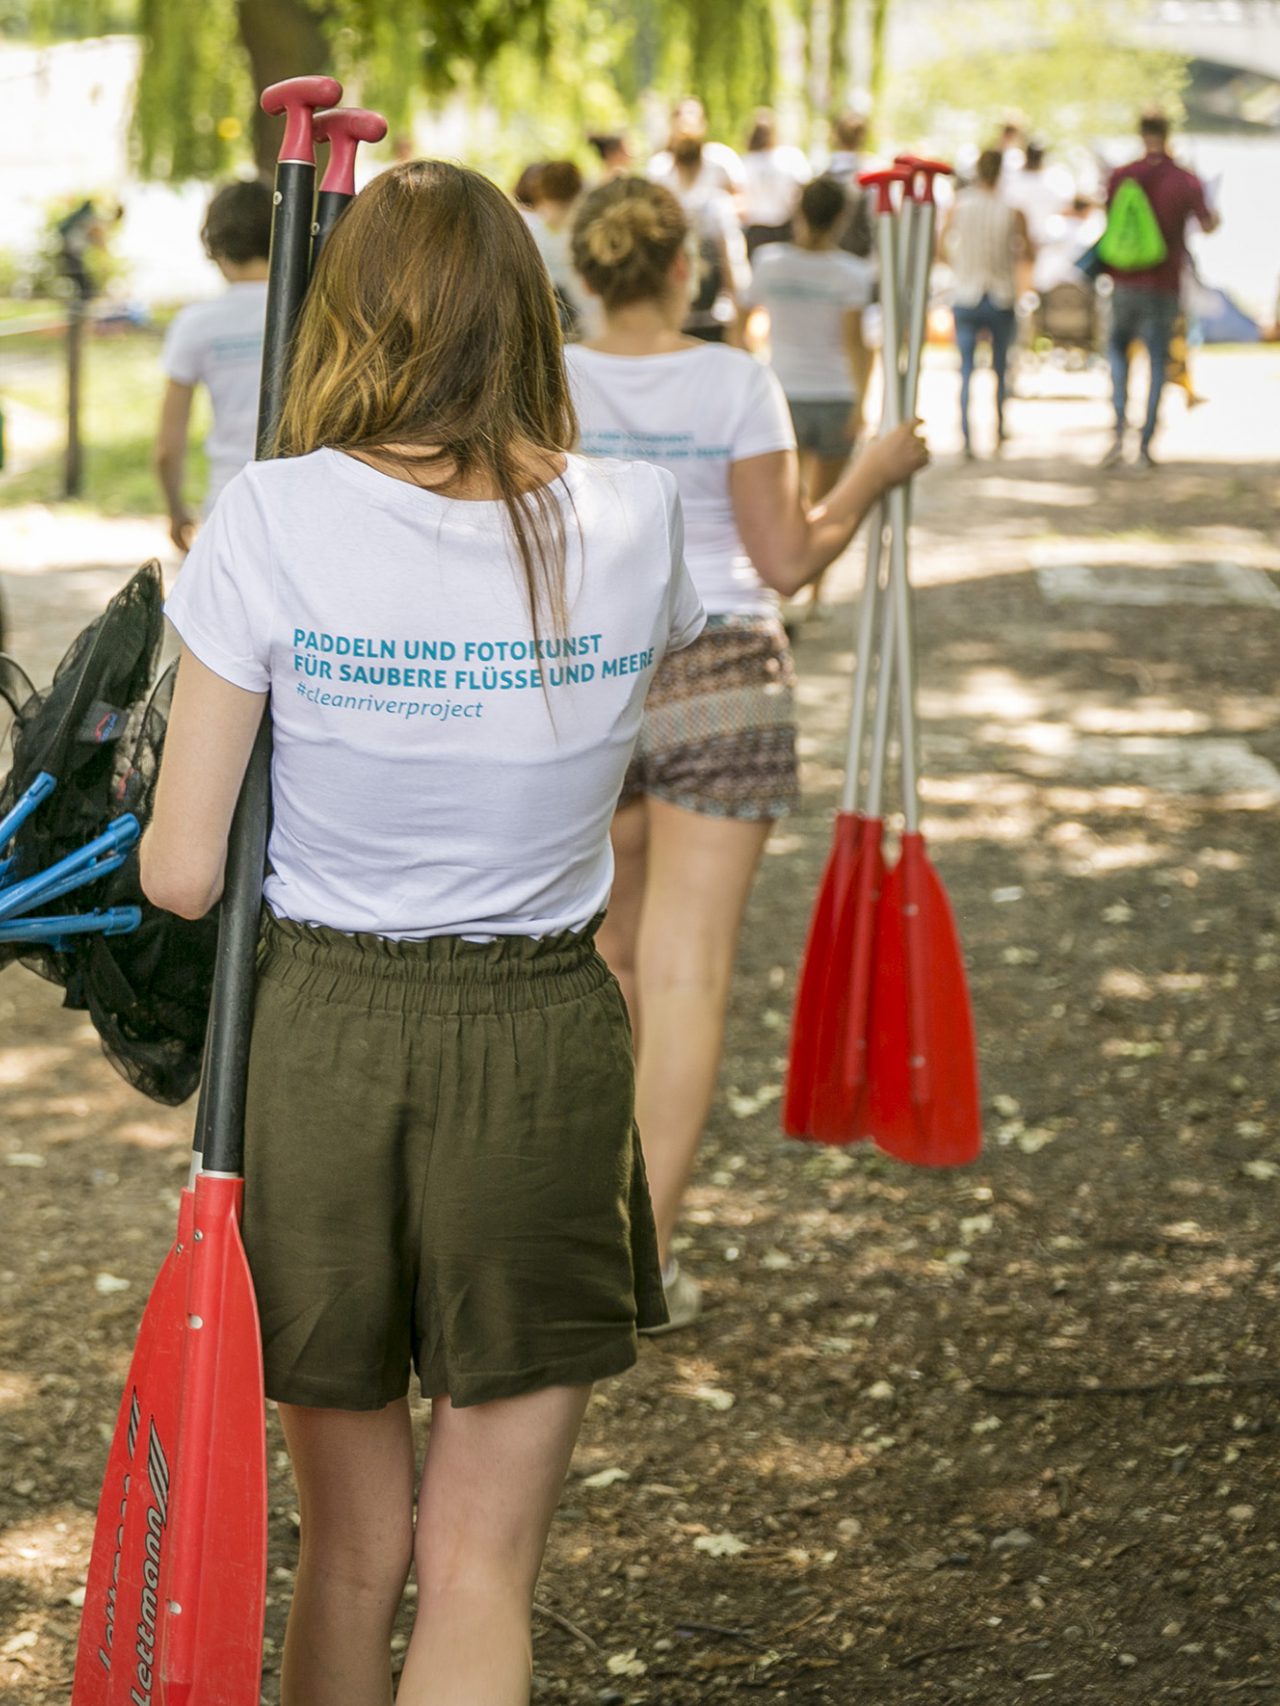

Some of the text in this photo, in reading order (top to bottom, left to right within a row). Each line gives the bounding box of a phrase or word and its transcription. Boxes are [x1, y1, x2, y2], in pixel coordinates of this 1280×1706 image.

[293, 628, 602, 662] PADDELN UND FOTOKUNST
[294, 647, 655, 690] FÜR SAUBERE FLÜSSE UND MEERE
[296, 681, 484, 721] #cleanriverproject
[131, 1505, 164, 1706] Lettmann
